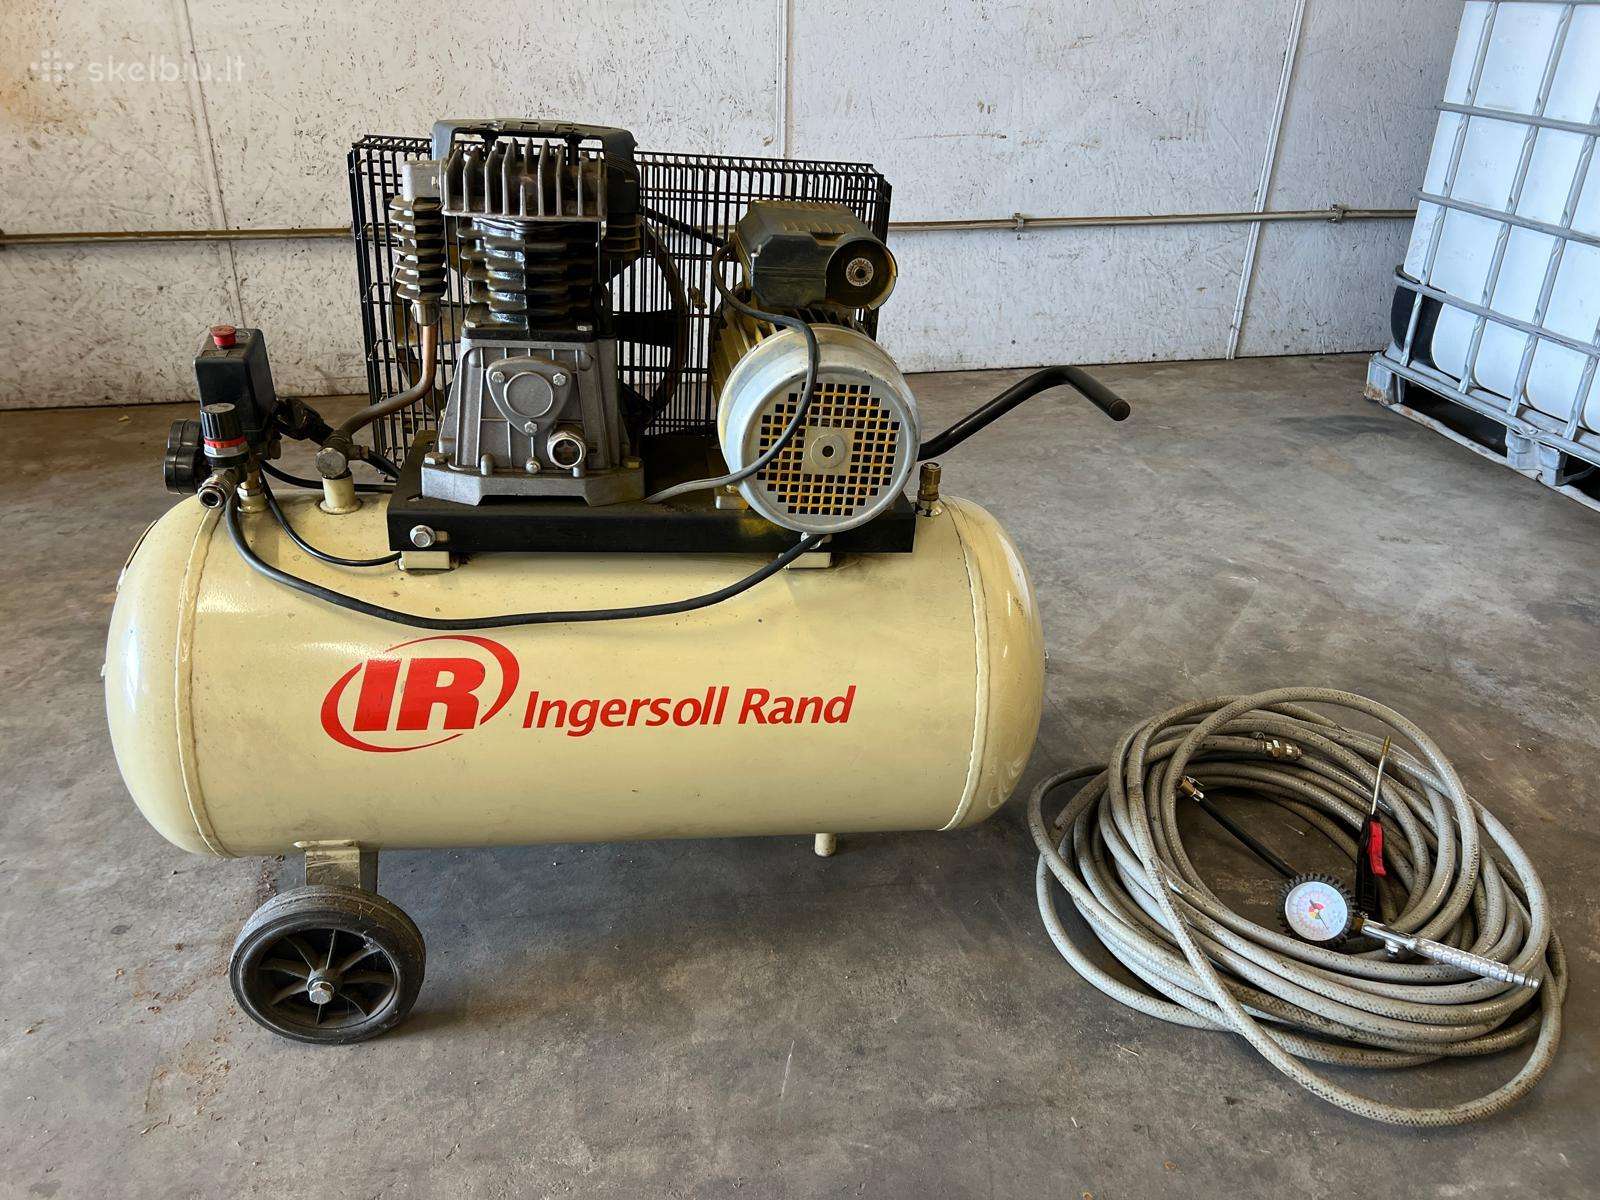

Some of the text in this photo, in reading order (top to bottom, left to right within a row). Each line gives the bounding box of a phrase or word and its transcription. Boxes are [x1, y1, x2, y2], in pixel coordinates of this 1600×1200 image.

[352, 657, 486, 733] IR
[522, 684, 857, 737] Ingersoll Rand
